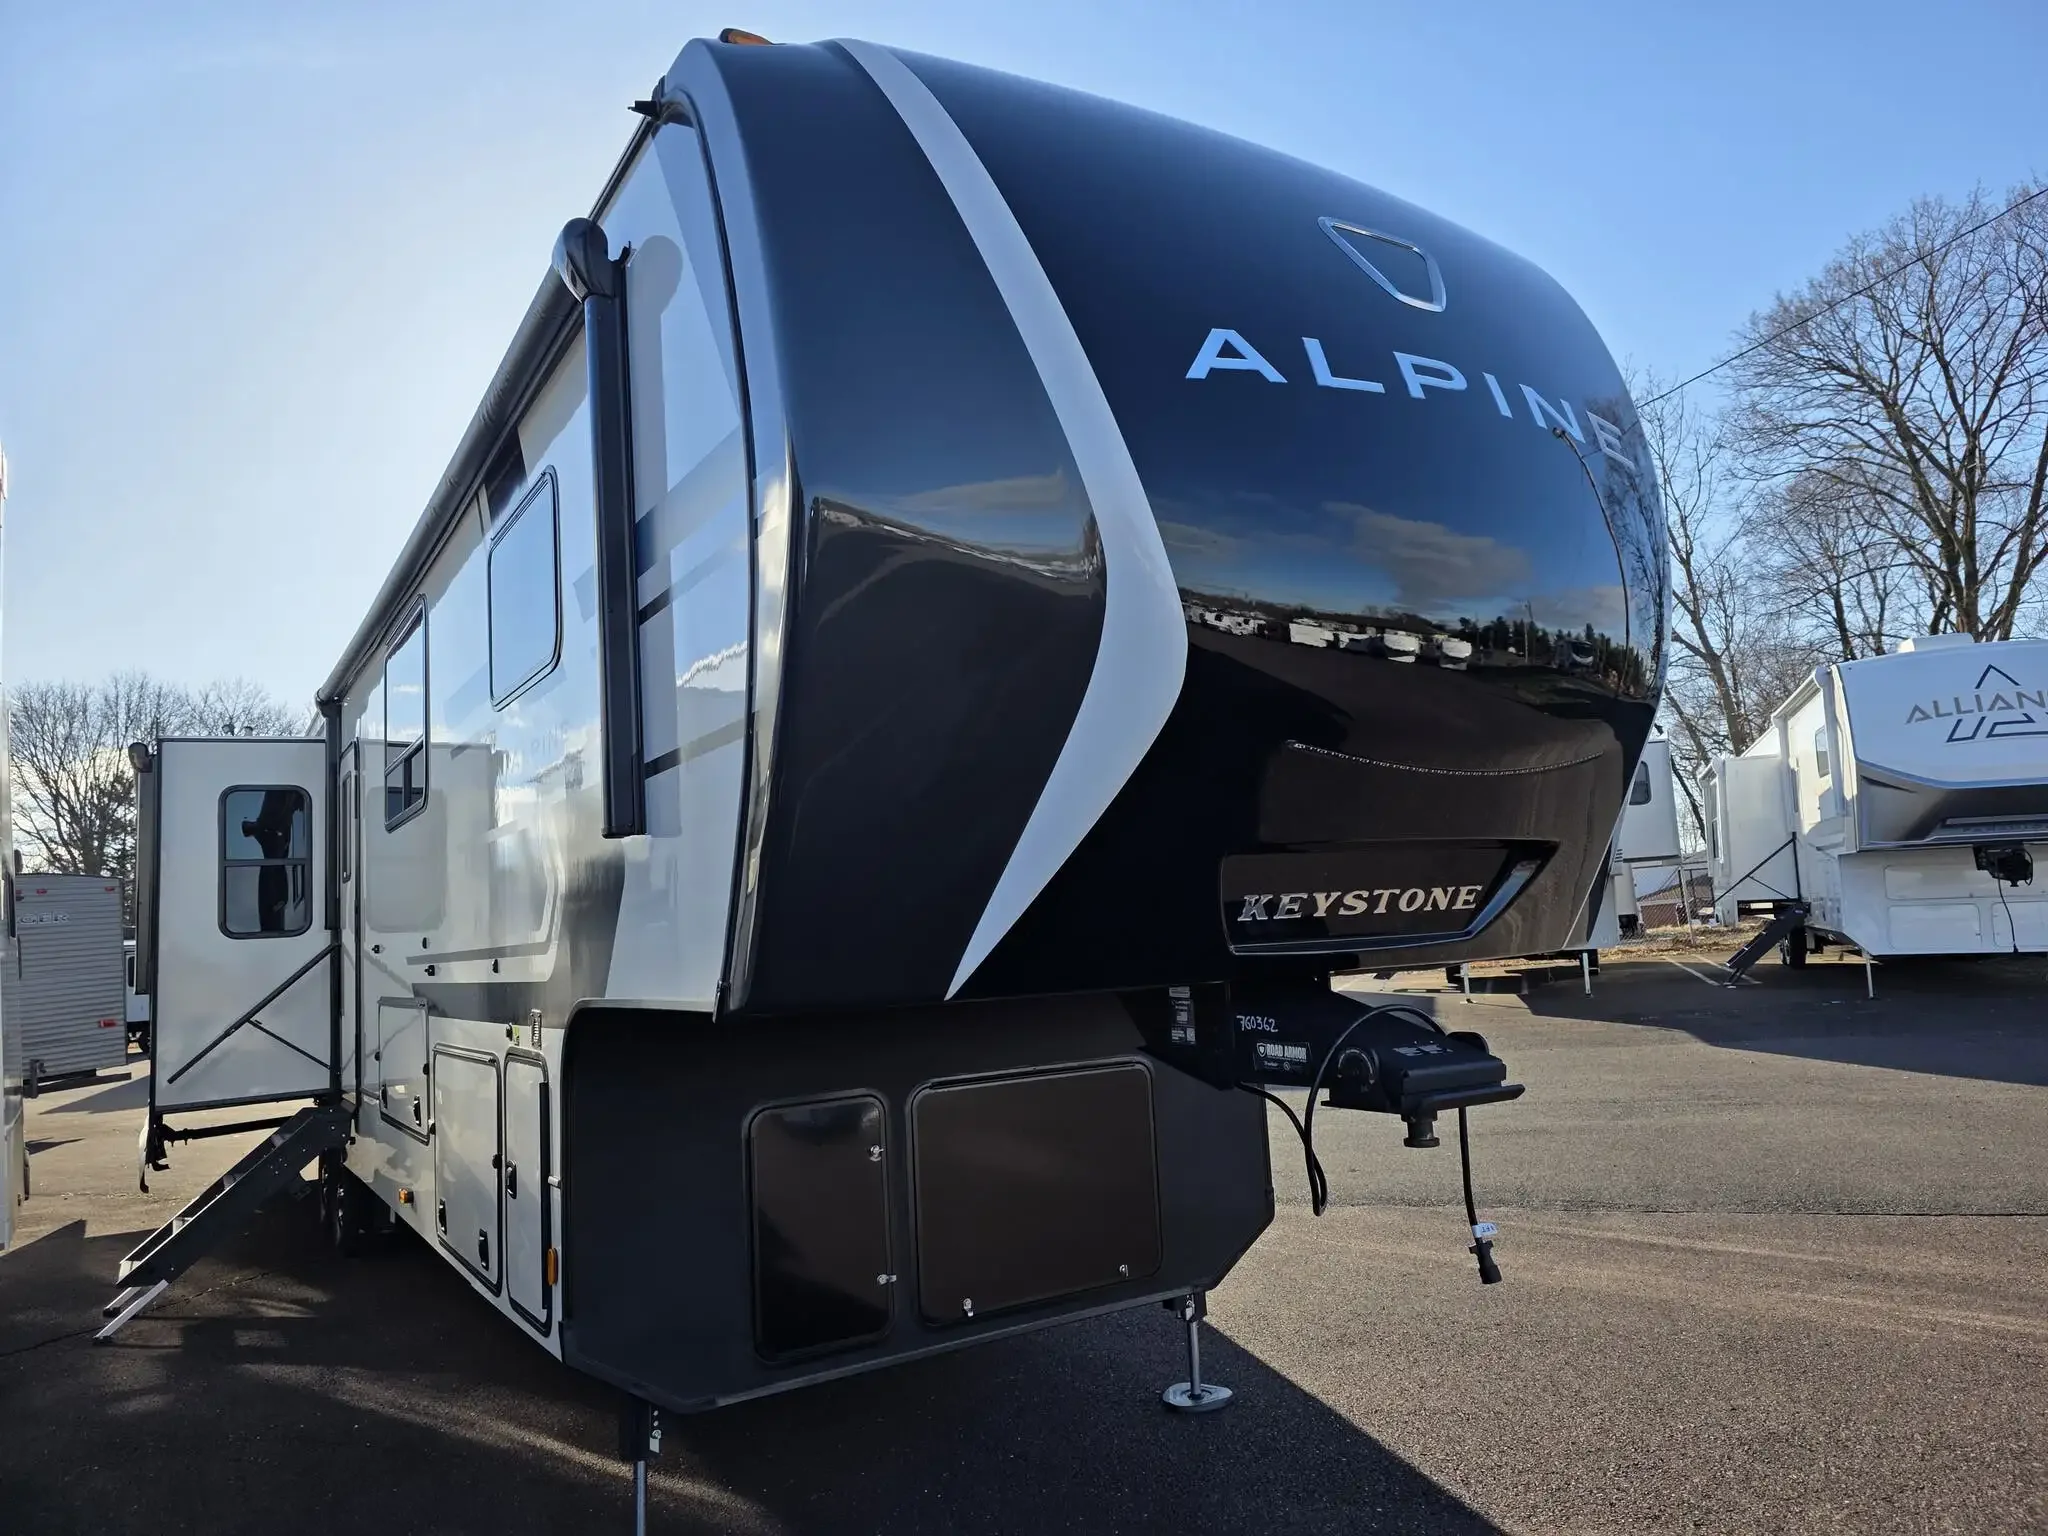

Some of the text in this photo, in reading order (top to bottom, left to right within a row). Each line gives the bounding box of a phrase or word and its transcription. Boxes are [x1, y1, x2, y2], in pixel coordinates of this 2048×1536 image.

[1185, 328, 1637, 474] ALPINE
[1906, 690, 2048, 724] ALLIAN
[1237, 885, 1482, 921] KEYSTONE
[1236, 1015, 1279, 1033] 760362
[1267, 1043, 1307, 1060] ROAD ARMOR
